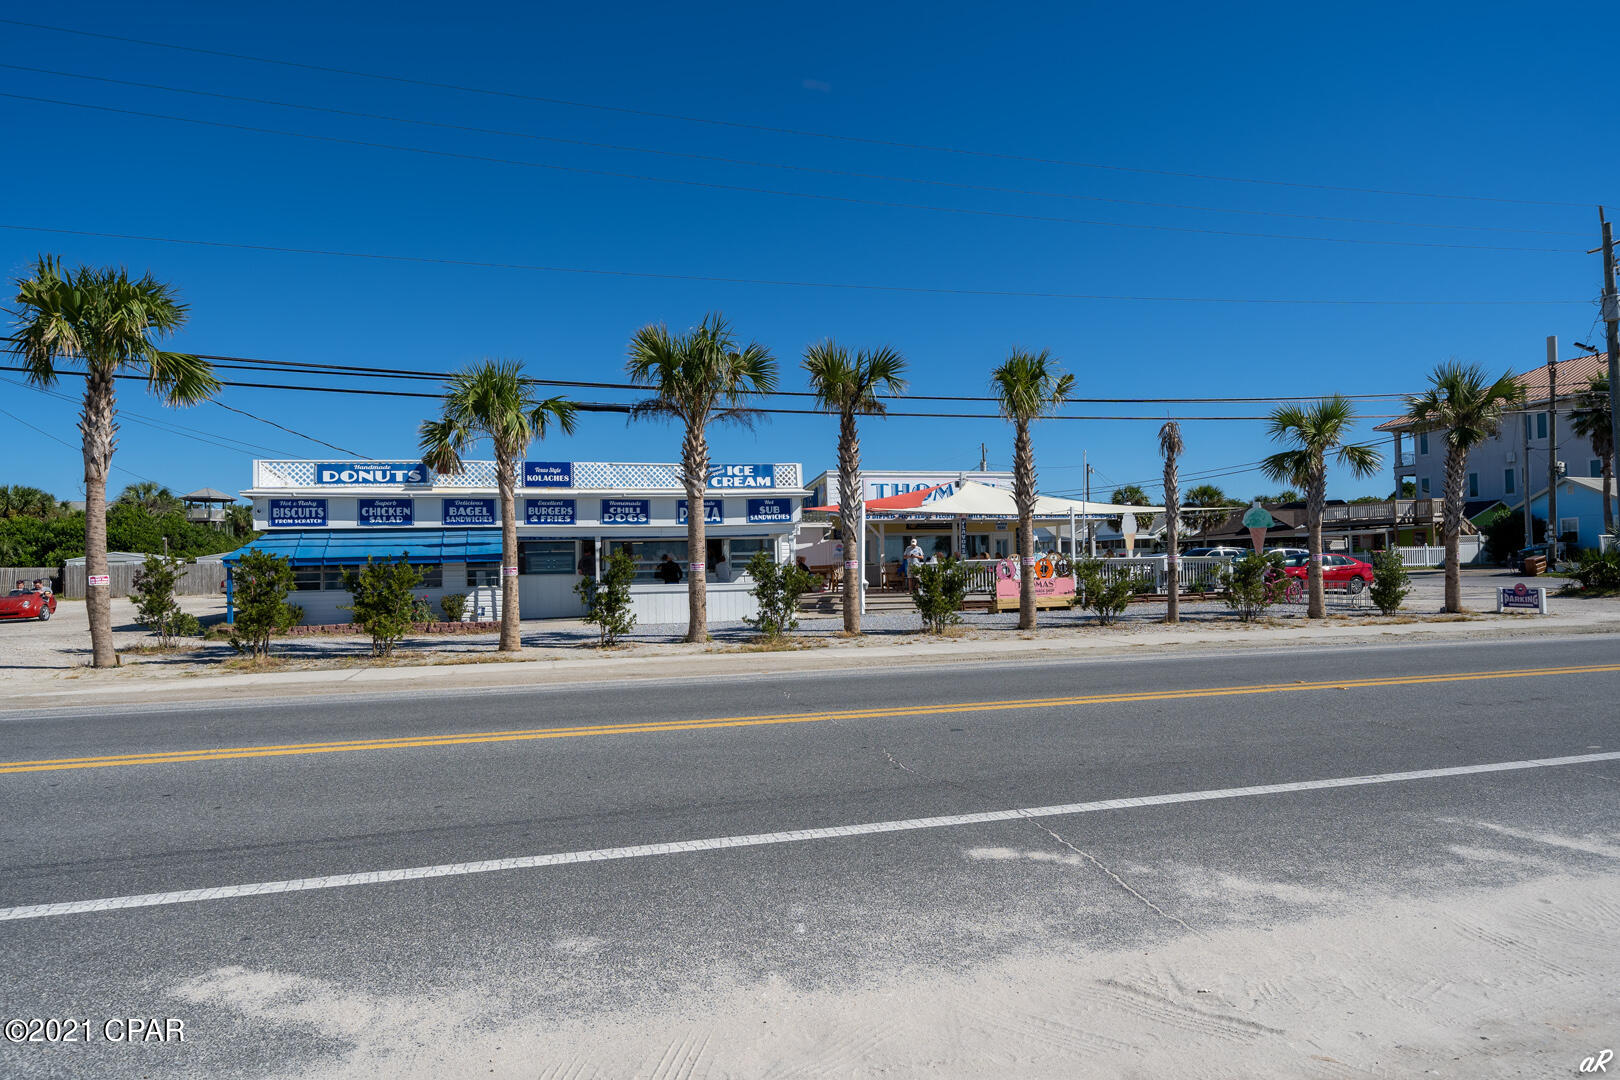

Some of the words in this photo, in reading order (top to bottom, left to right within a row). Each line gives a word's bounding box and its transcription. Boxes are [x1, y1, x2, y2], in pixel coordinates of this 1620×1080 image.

[726, 465, 754, 476] ICE
[322, 470, 422, 482] DONUTS
[711, 476, 772, 487] CREAM
[273, 507, 324, 518] BISCUITS
[361, 507, 411, 516] CHICKEN
[449, 506, 490, 516] BAGEL
[528, 507, 574, 515] BURGERS
[680, 507, 721, 522] PZA
[759, 505, 780, 514] SUB
[369, 515, 404, 523] SALAD
[603, 513, 648, 522] DOGS
[1503, 593, 1539, 605] PARKING
